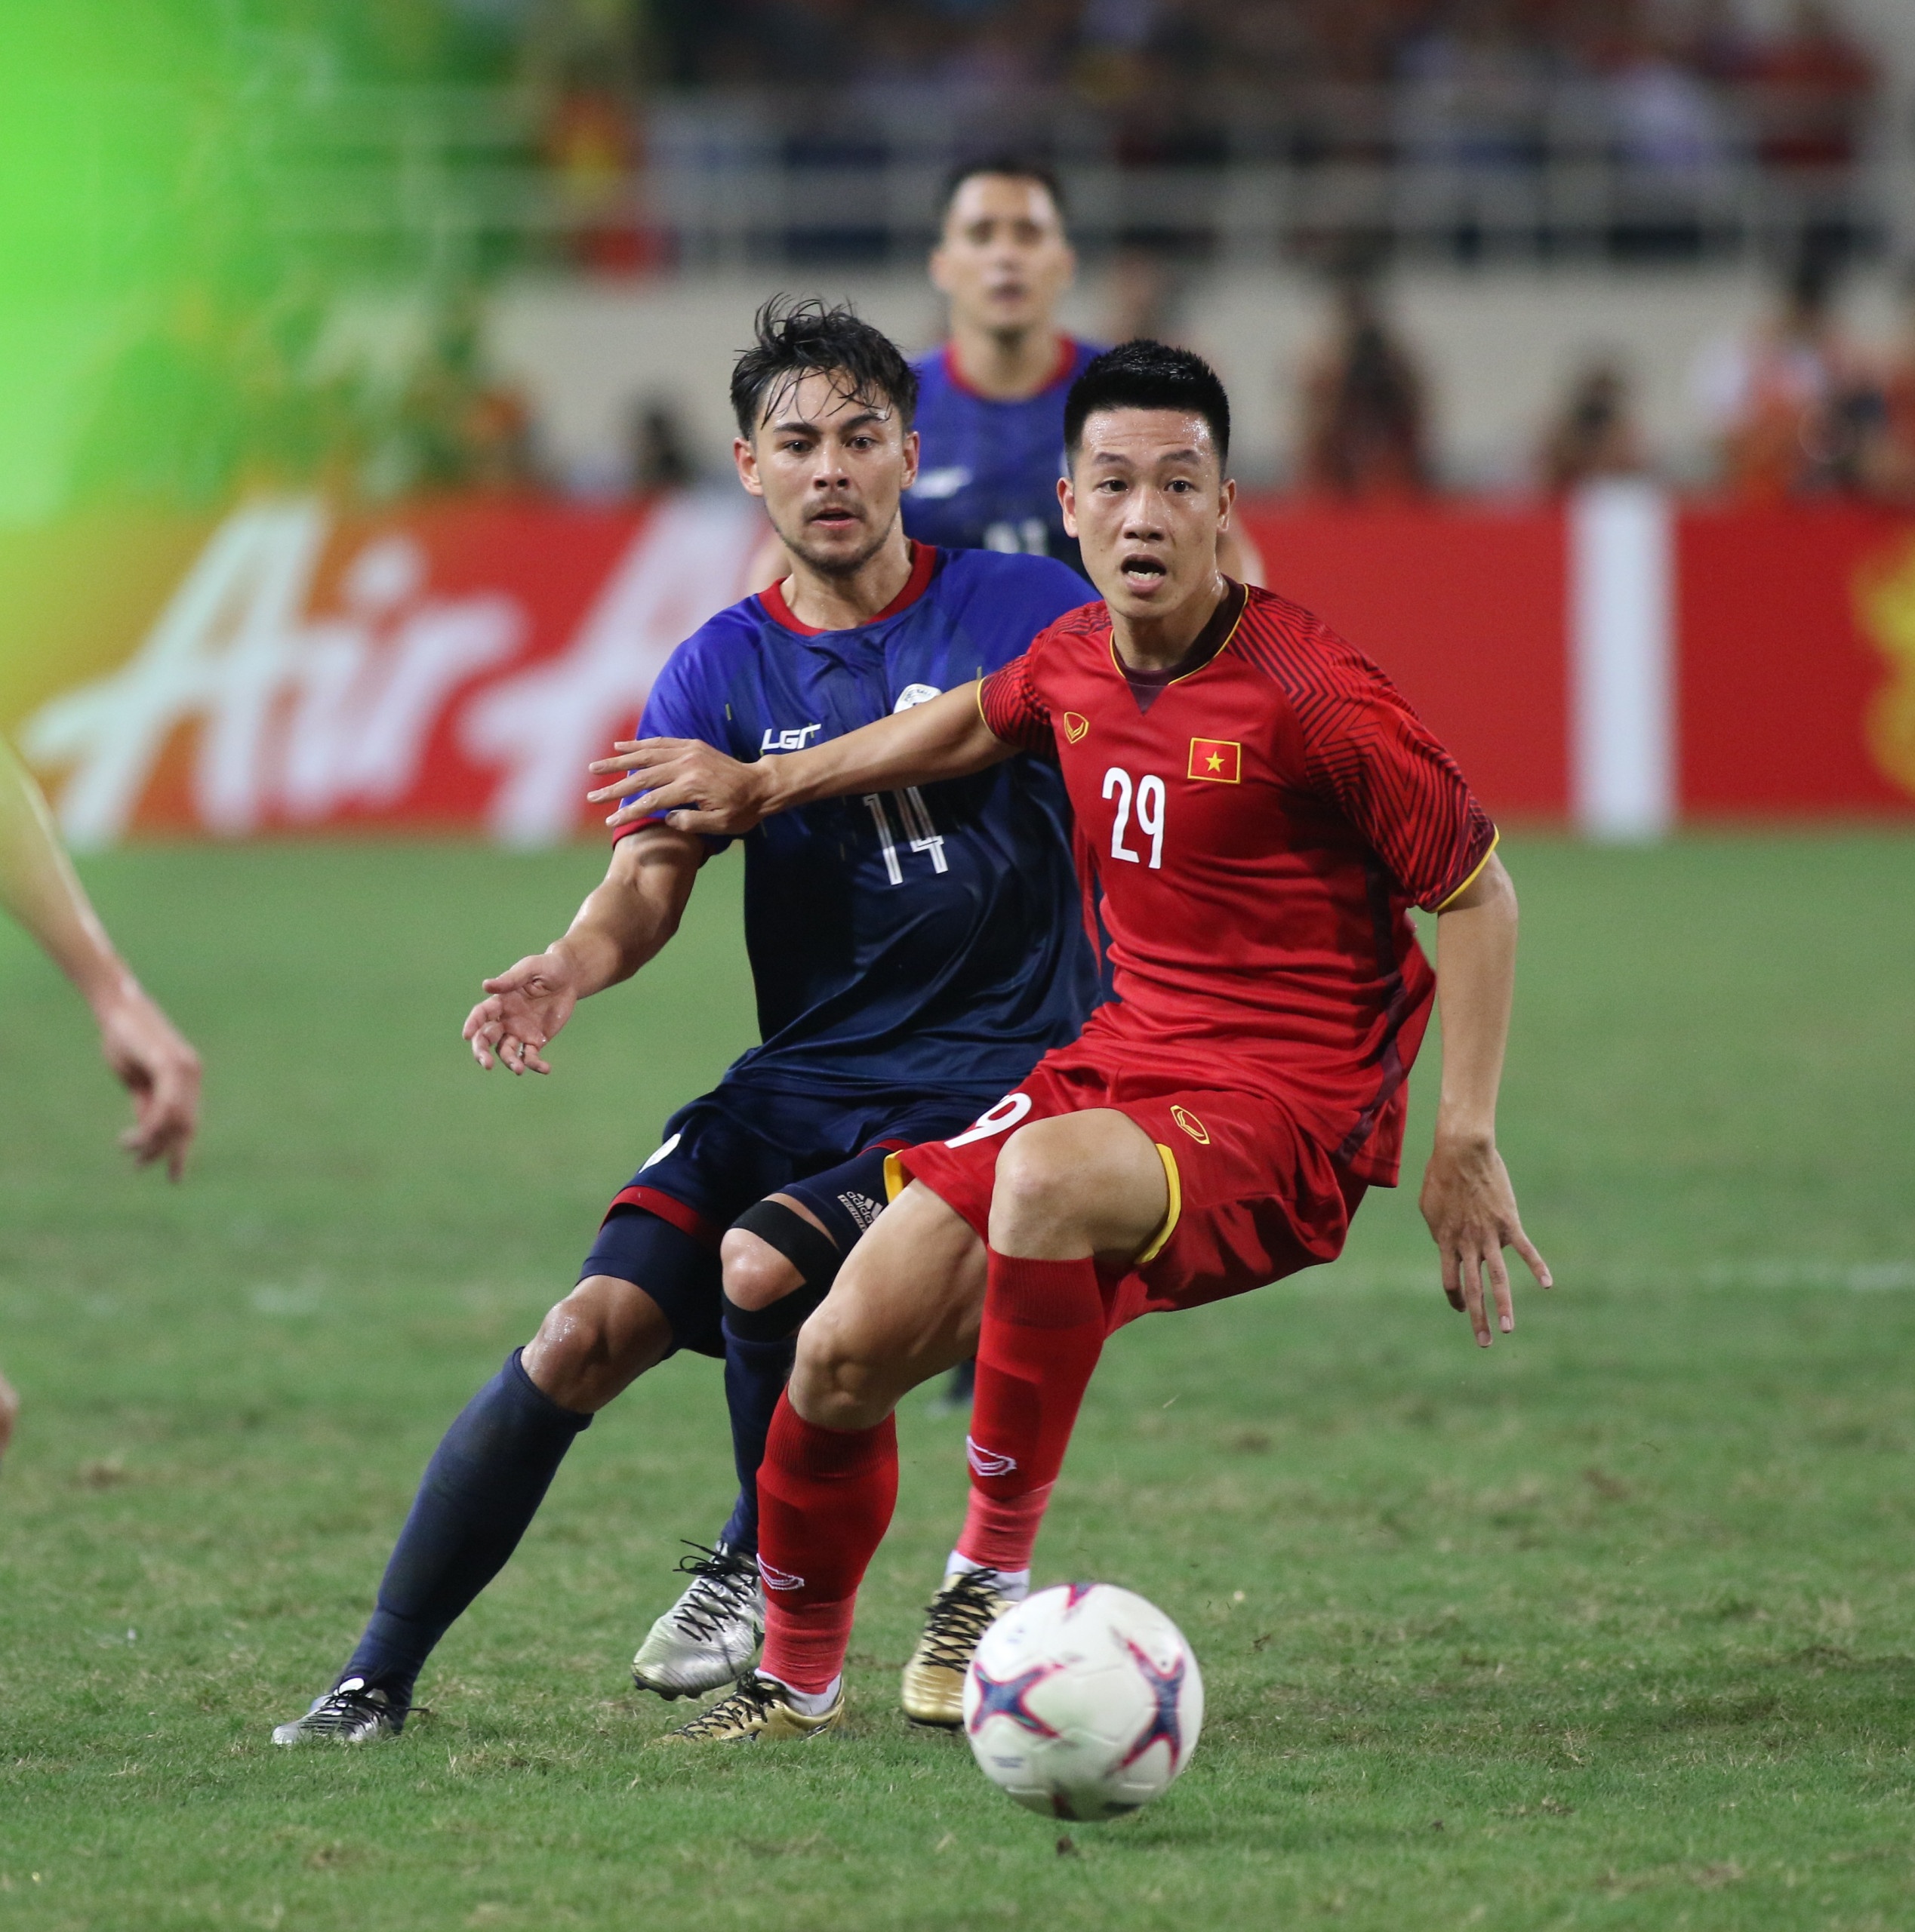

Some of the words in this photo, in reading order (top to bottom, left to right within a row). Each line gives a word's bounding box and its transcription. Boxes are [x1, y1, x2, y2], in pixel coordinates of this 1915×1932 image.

[862, 786, 949, 886] 14
[1101, 767, 1166, 869] 29
[846, 1191, 875, 1225] adida
